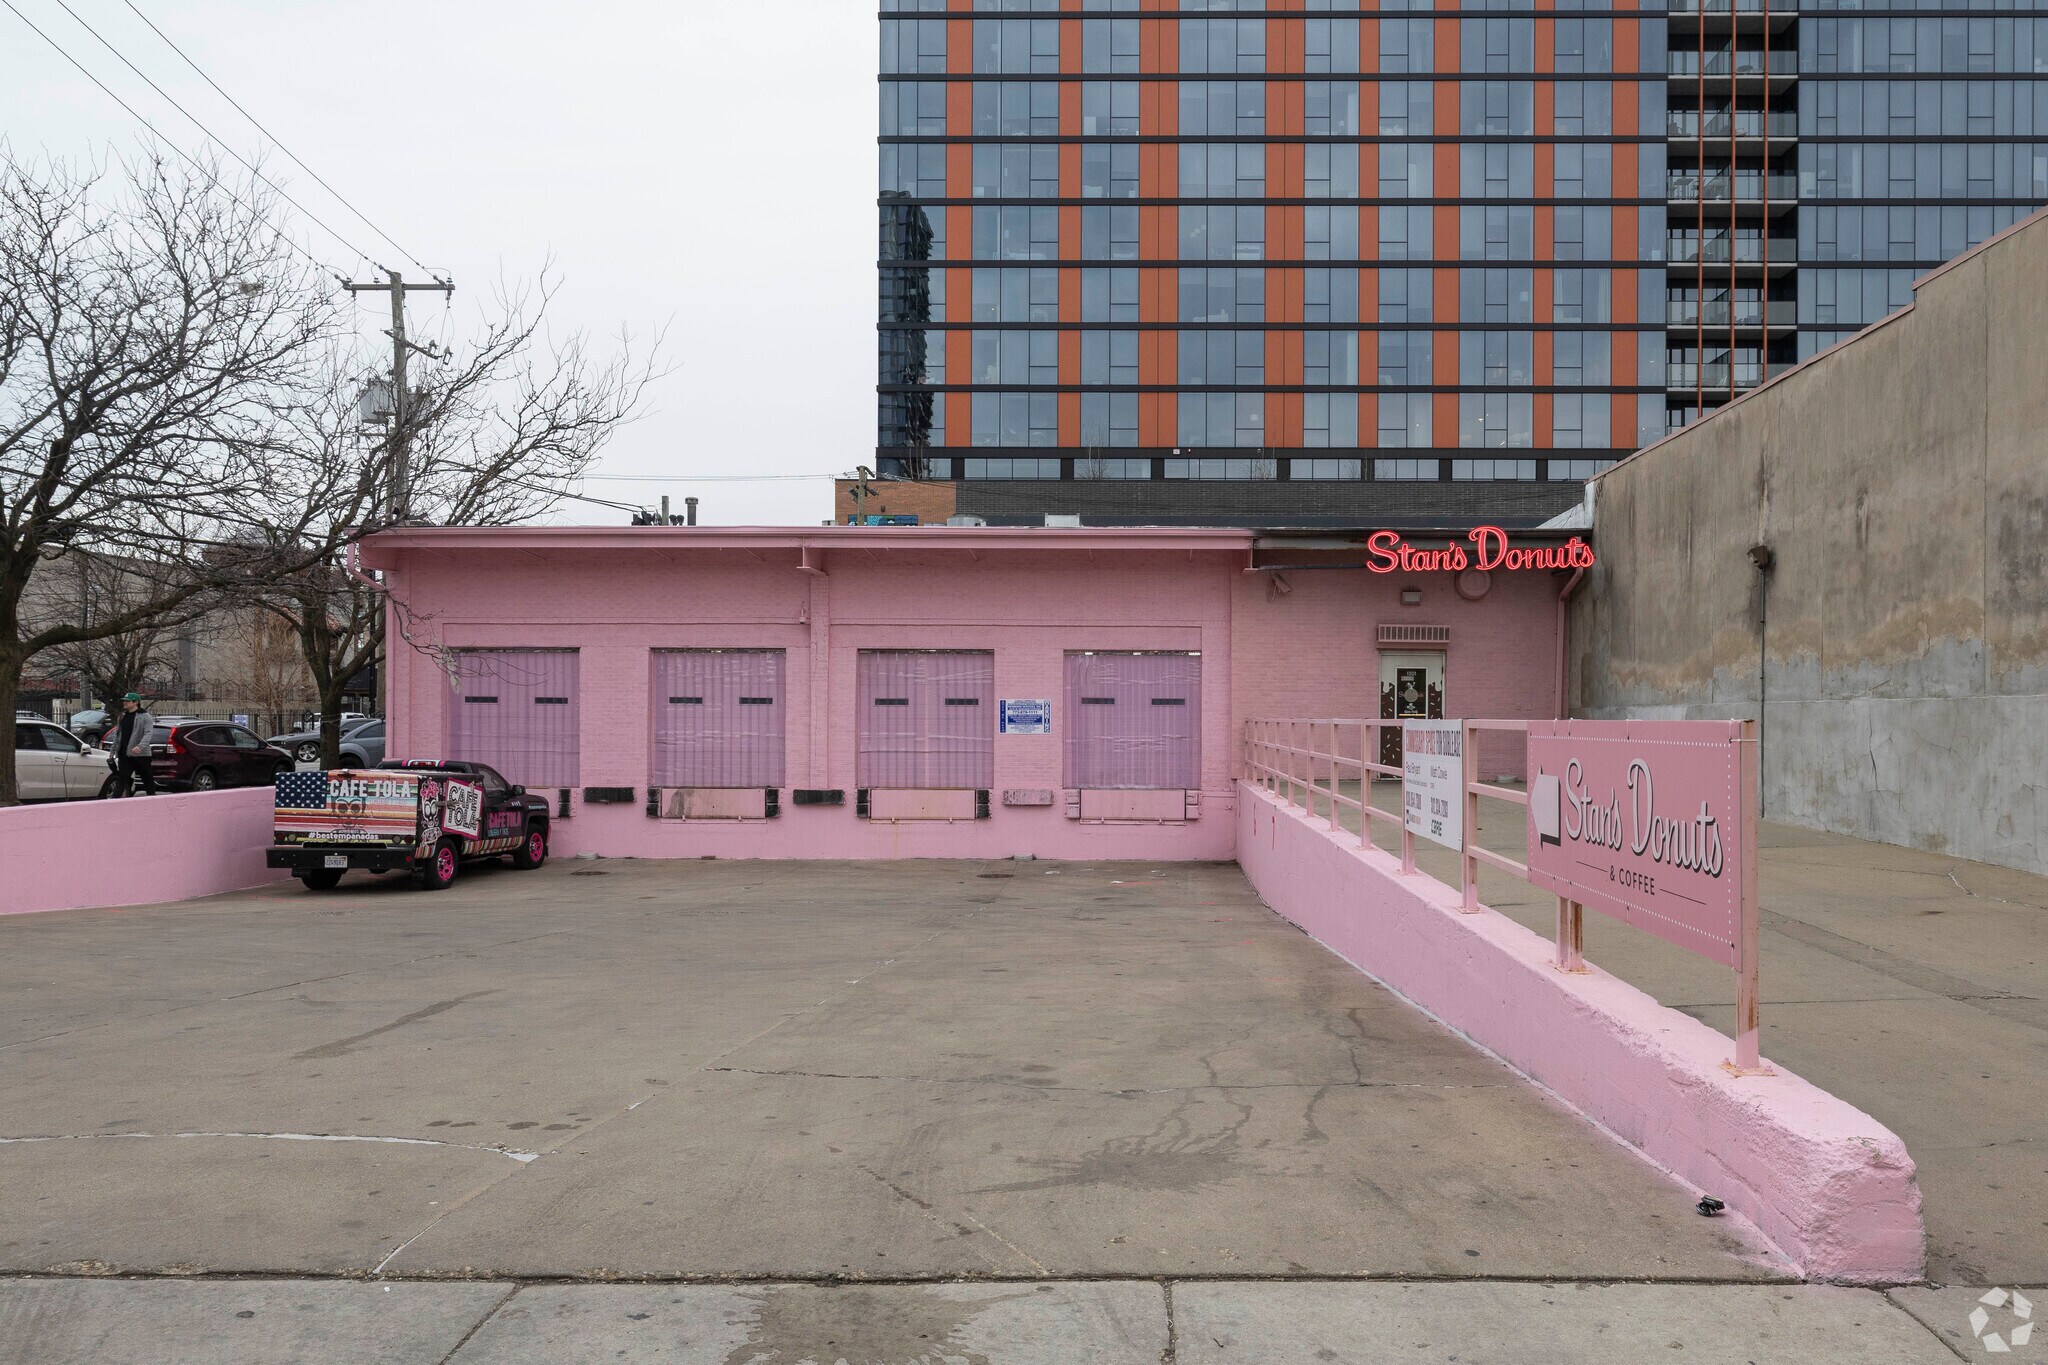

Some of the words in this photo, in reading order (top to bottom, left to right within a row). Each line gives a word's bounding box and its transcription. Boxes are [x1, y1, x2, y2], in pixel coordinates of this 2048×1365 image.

[1366, 530, 1468, 574] Stan's
[1468, 524, 1596, 571] Donuts
[329, 779, 368, 798] CAFE
[373, 780, 411, 798] TOLA
[1565, 757, 1623, 852] Stan's
[1626, 757, 1724, 878] Donuts
[308, 831, 379, 841] #bestempanadas
[1609, 865, 1616, 881] &
[1618, 868, 1655, 895] COFFEE
